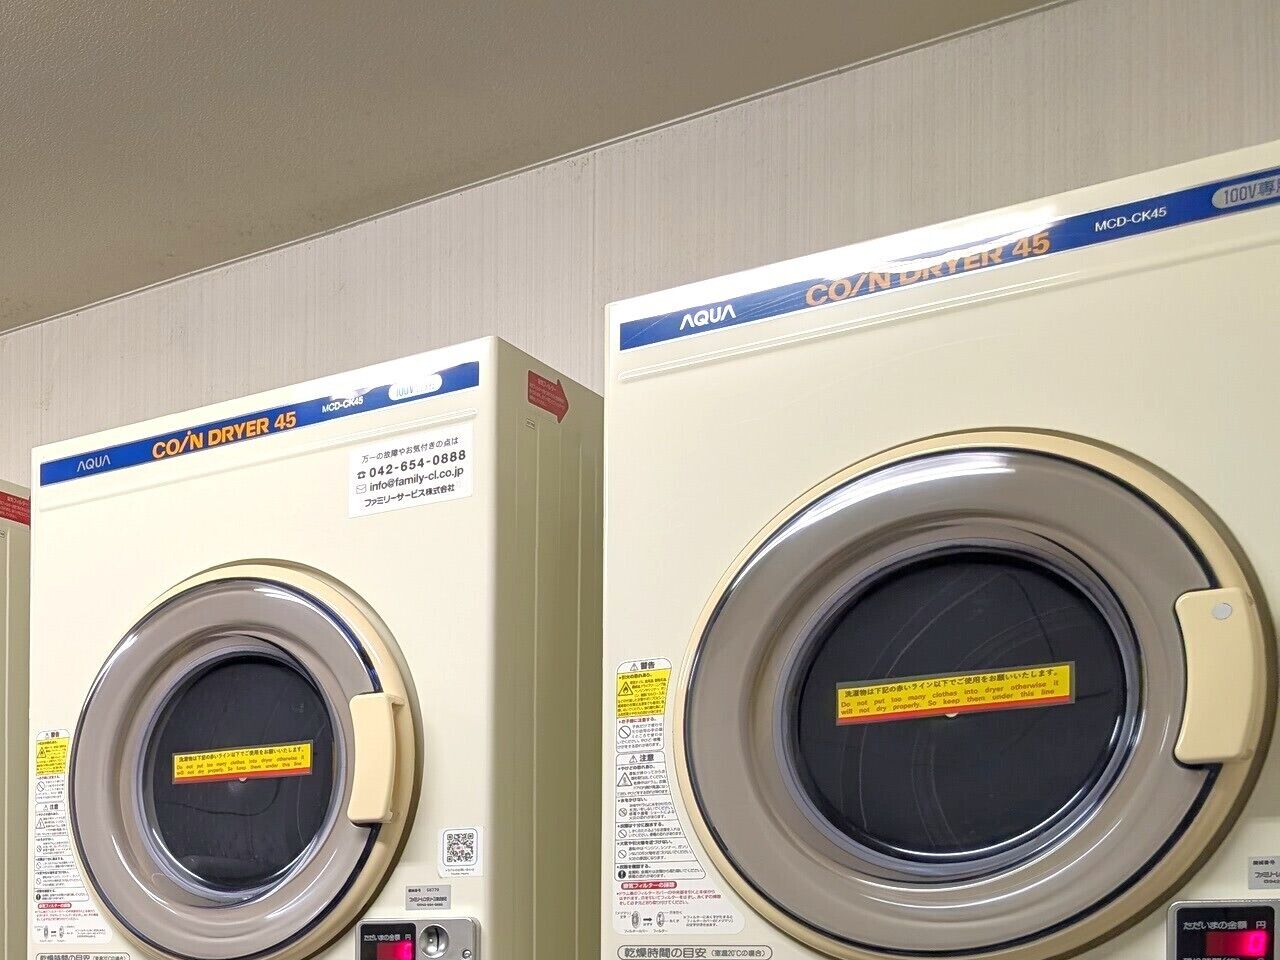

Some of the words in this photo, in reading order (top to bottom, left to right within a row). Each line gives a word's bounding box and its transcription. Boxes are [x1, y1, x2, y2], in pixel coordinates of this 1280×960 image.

[1095, 206, 1167, 232] MCD-CK45
[1012, 231, 1051, 257] 45
[679, 303, 737, 331] AQUA
[208, 417, 269, 446] DRYER
[274, 411, 297, 430] 45
[362, 437, 459, 464] 万一の故障やお気付きの点は
[77, 455, 111, 472] AQUA
[369, 450, 466, 478] 042-654-0888
[369, 466, 464, 492] info@family-cl.co.jp
[364, 483, 455, 508] ファミリーサービス株式会社
[640, 661, 655, 669] 警告
[932, 690, 958, 699] clothes
[964, 687, 978, 695] into
[985, 686, 1004, 695] dryer
[1010, 682, 1047, 691] otherwise
[639, 754, 655, 762] 注意
[1183, 920, 1248, 930] ただいまの金額
[1255, 920, 1267, 929] 円
[624, 947, 707, 959] 乾燥時間の目安
